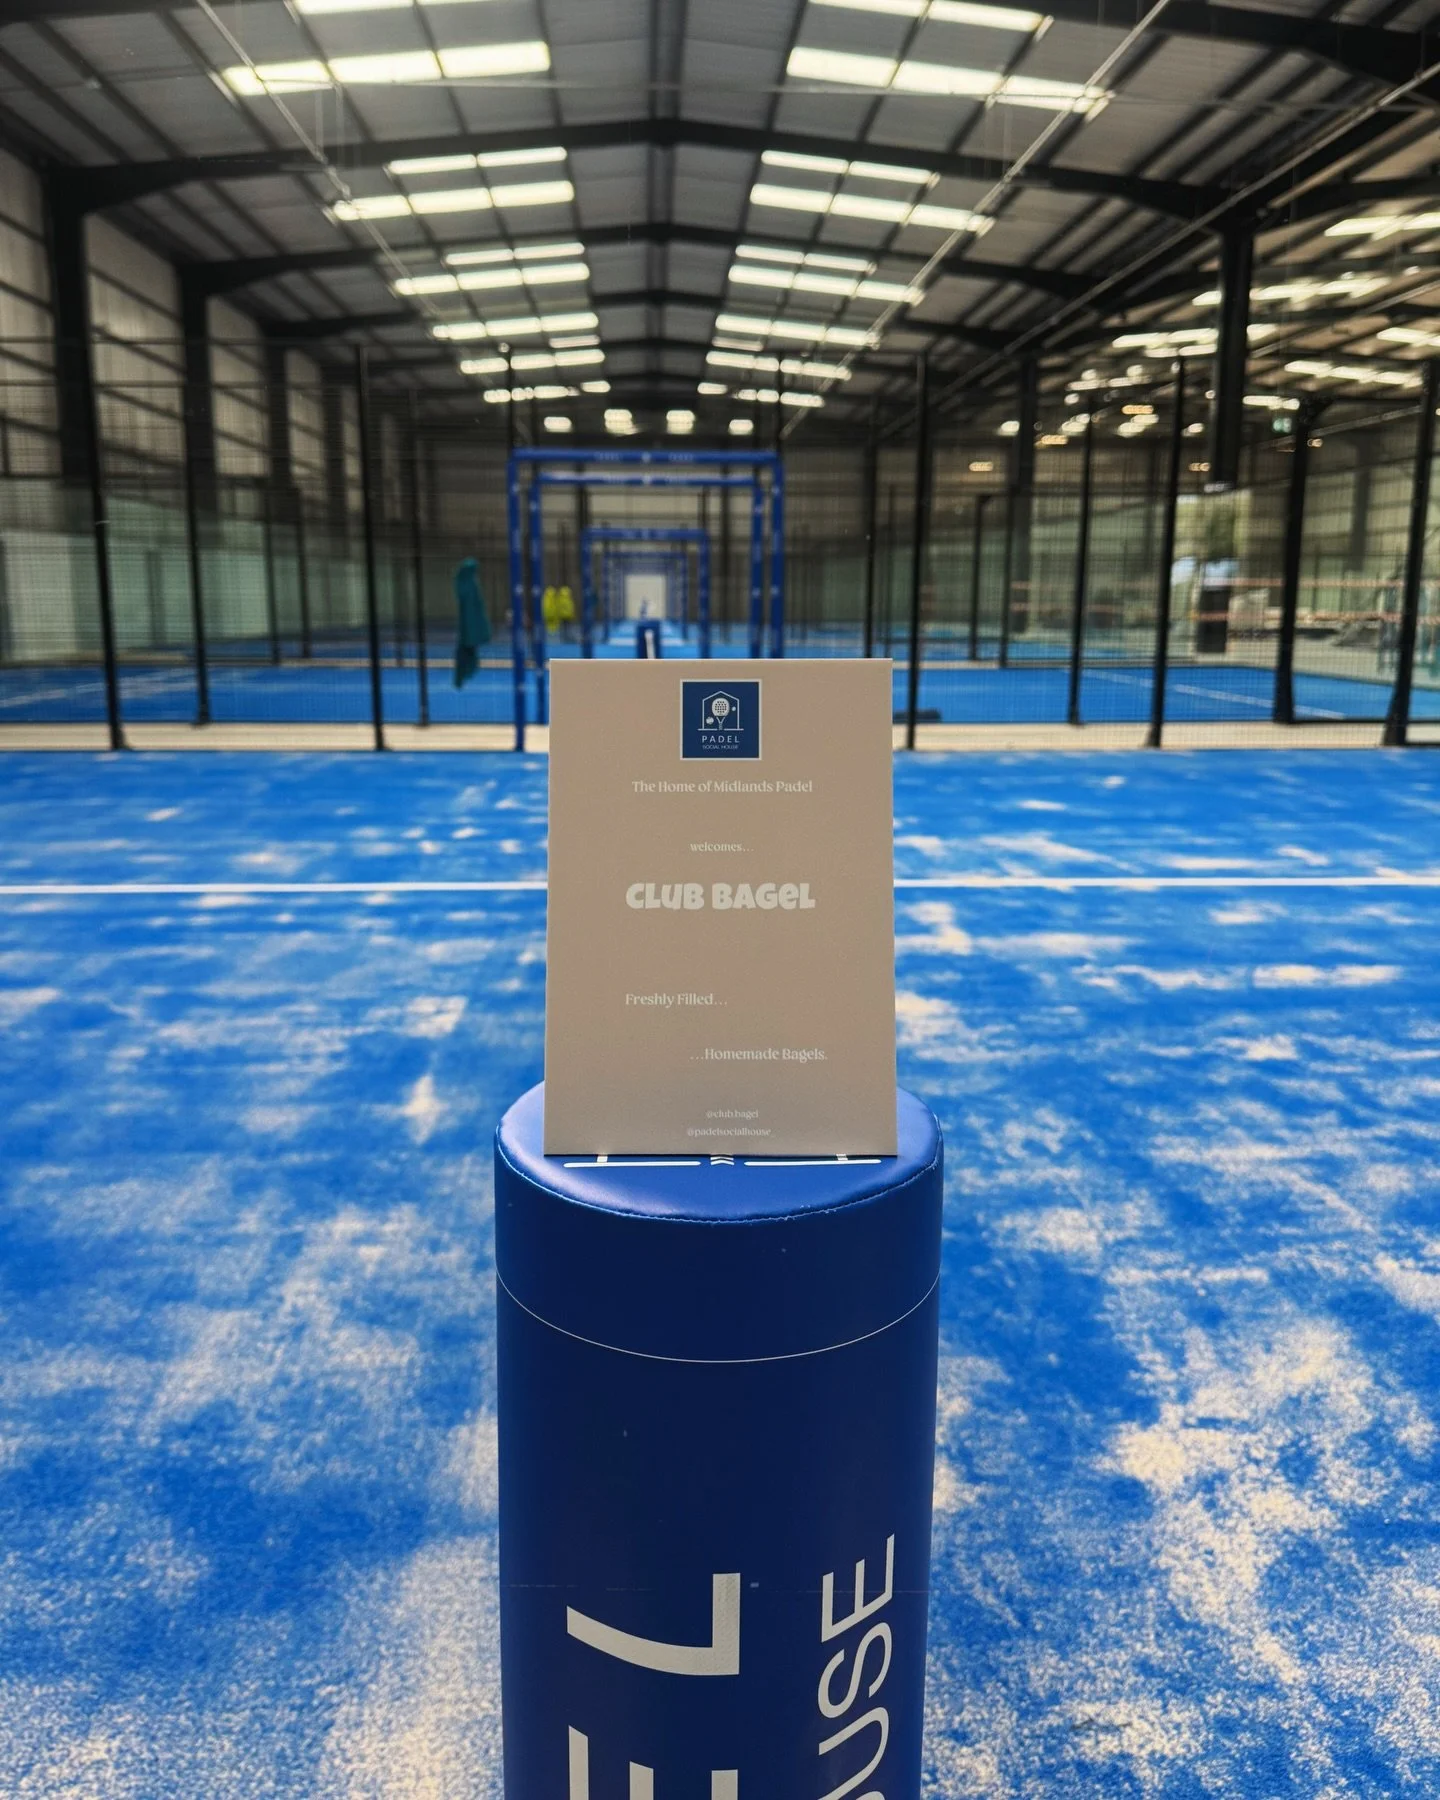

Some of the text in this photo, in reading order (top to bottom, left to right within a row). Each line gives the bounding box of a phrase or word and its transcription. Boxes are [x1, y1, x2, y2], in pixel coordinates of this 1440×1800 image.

[701, 734, 740, 744] PADEL
[631, 780, 813, 793] The Home of Midlands Padel
[625, 882, 705, 910] CLUB
[625, 992, 675, 1009] Freshly
[781, 1047, 828, 1063] Bagels.
[817, 1533, 895, 1800] USE
